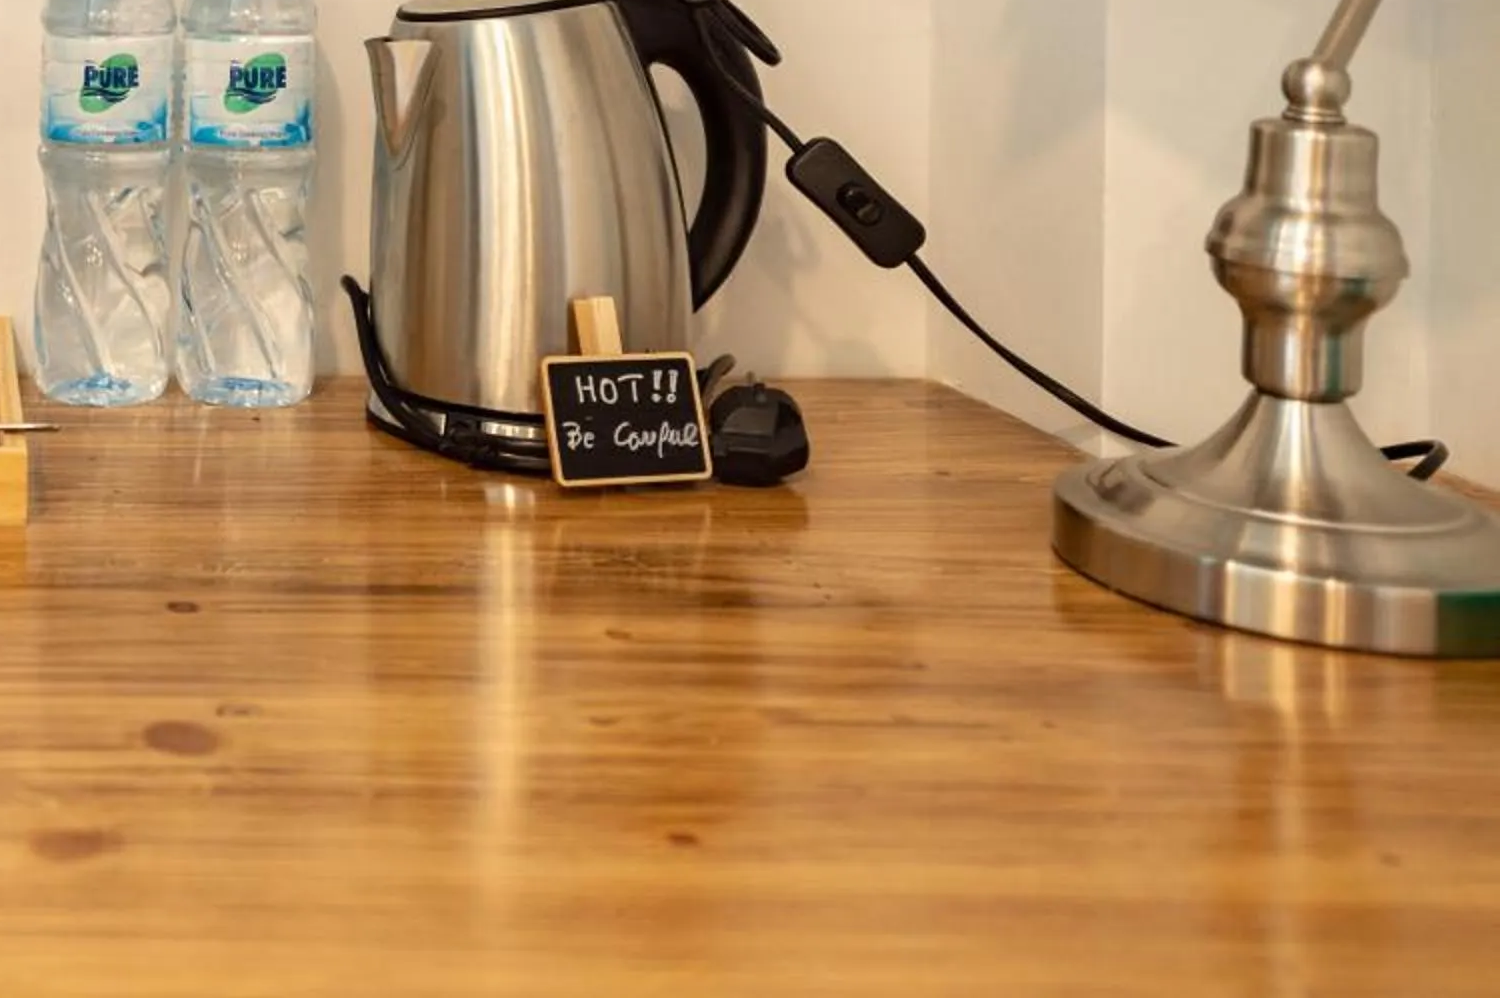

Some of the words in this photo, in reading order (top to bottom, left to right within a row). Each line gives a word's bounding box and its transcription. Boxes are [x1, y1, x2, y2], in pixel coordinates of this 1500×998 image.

[84, 65, 140, 88] PURE
[229, 65, 288, 89] PURE
[562, 421, 596, 451] Be
